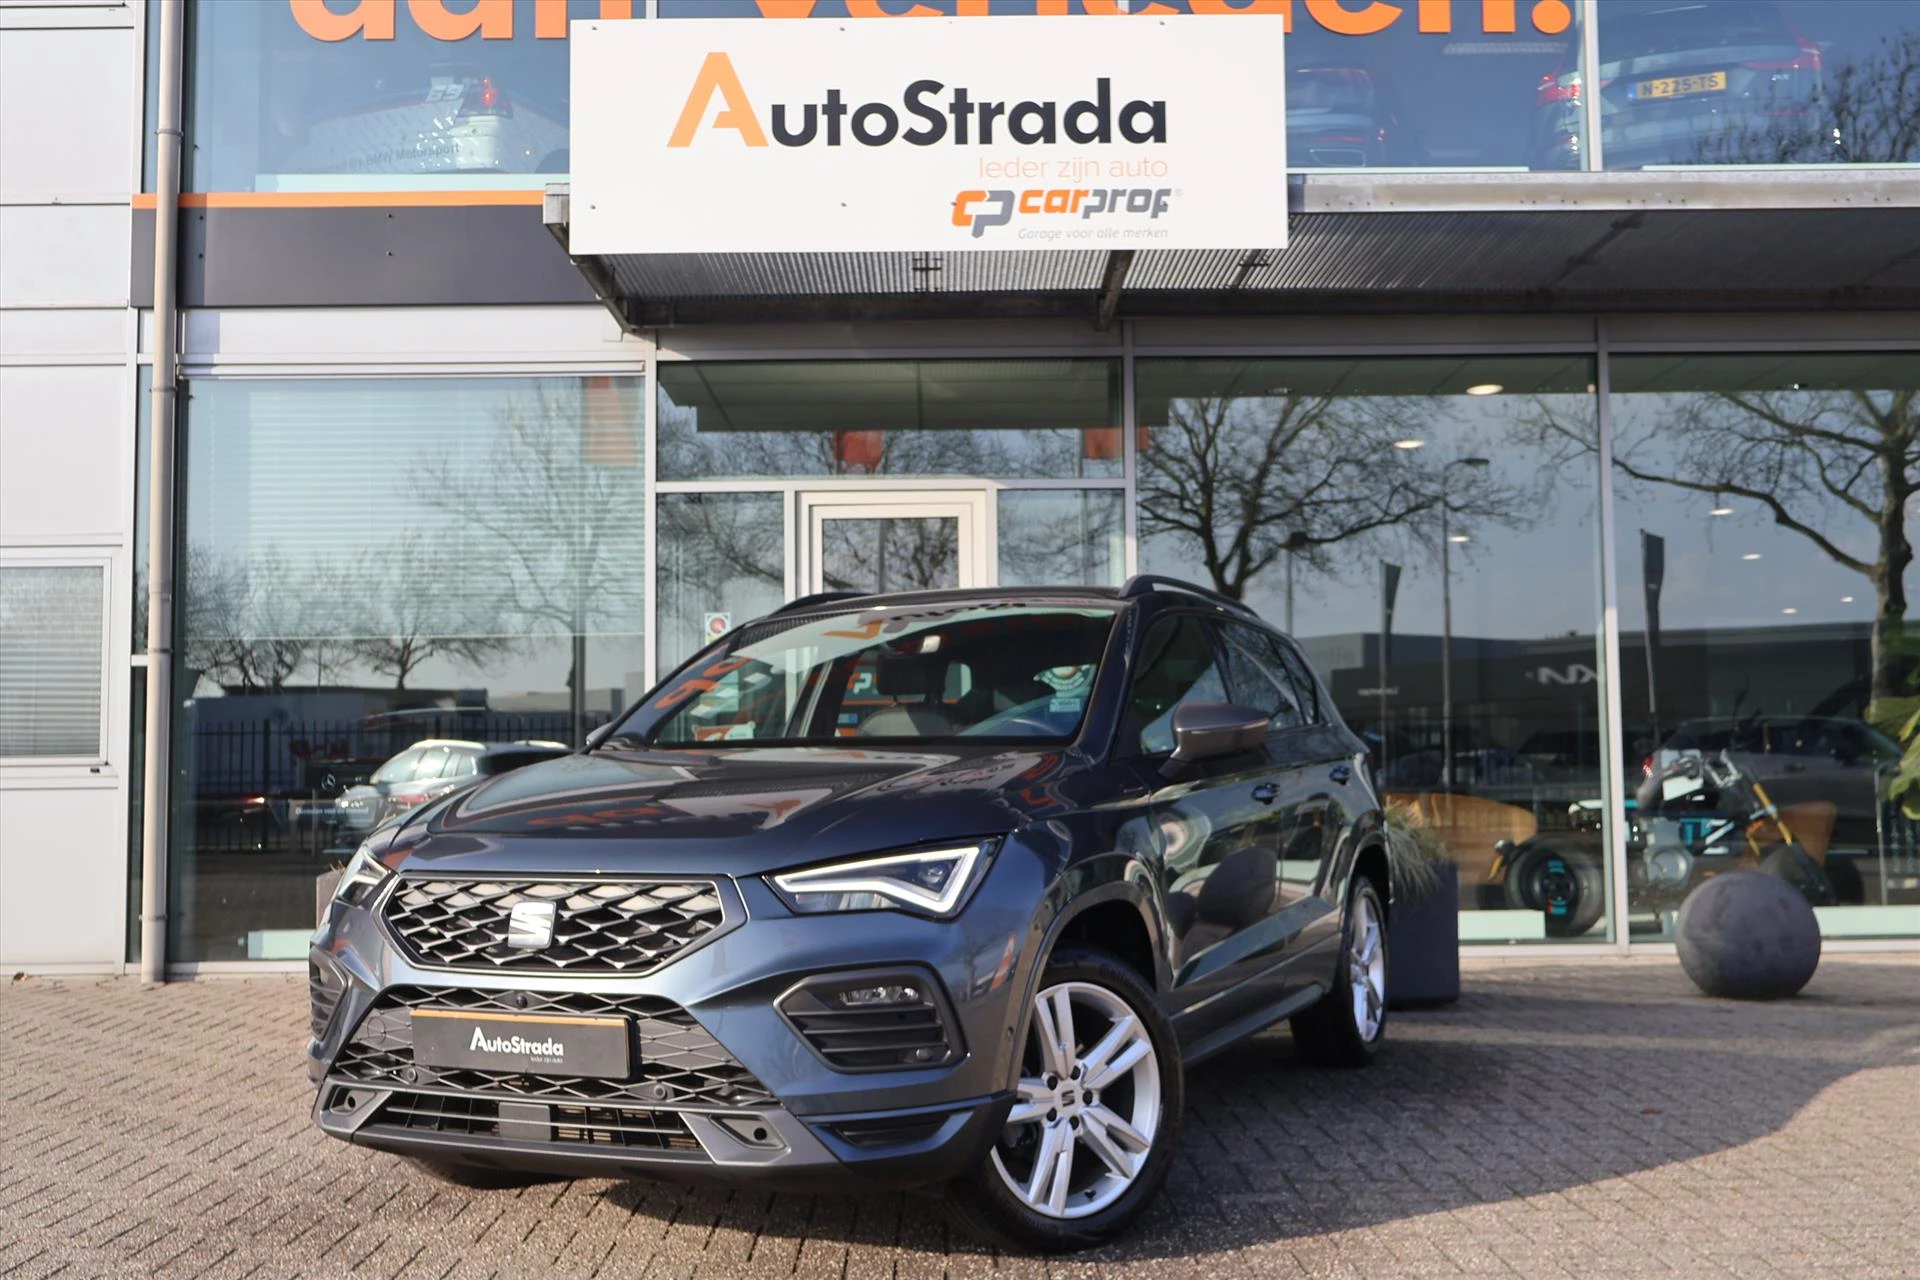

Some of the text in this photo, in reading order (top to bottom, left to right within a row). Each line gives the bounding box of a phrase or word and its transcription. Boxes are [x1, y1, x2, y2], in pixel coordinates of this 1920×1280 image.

[666, 52, 1167, 147] AutoStrada
[978, 156, 1168, 183] Ieder zijn auto
[1018, 227, 1169, 241] Garage voor alle merken
[469, 1026, 564, 1057] AutoStrada
